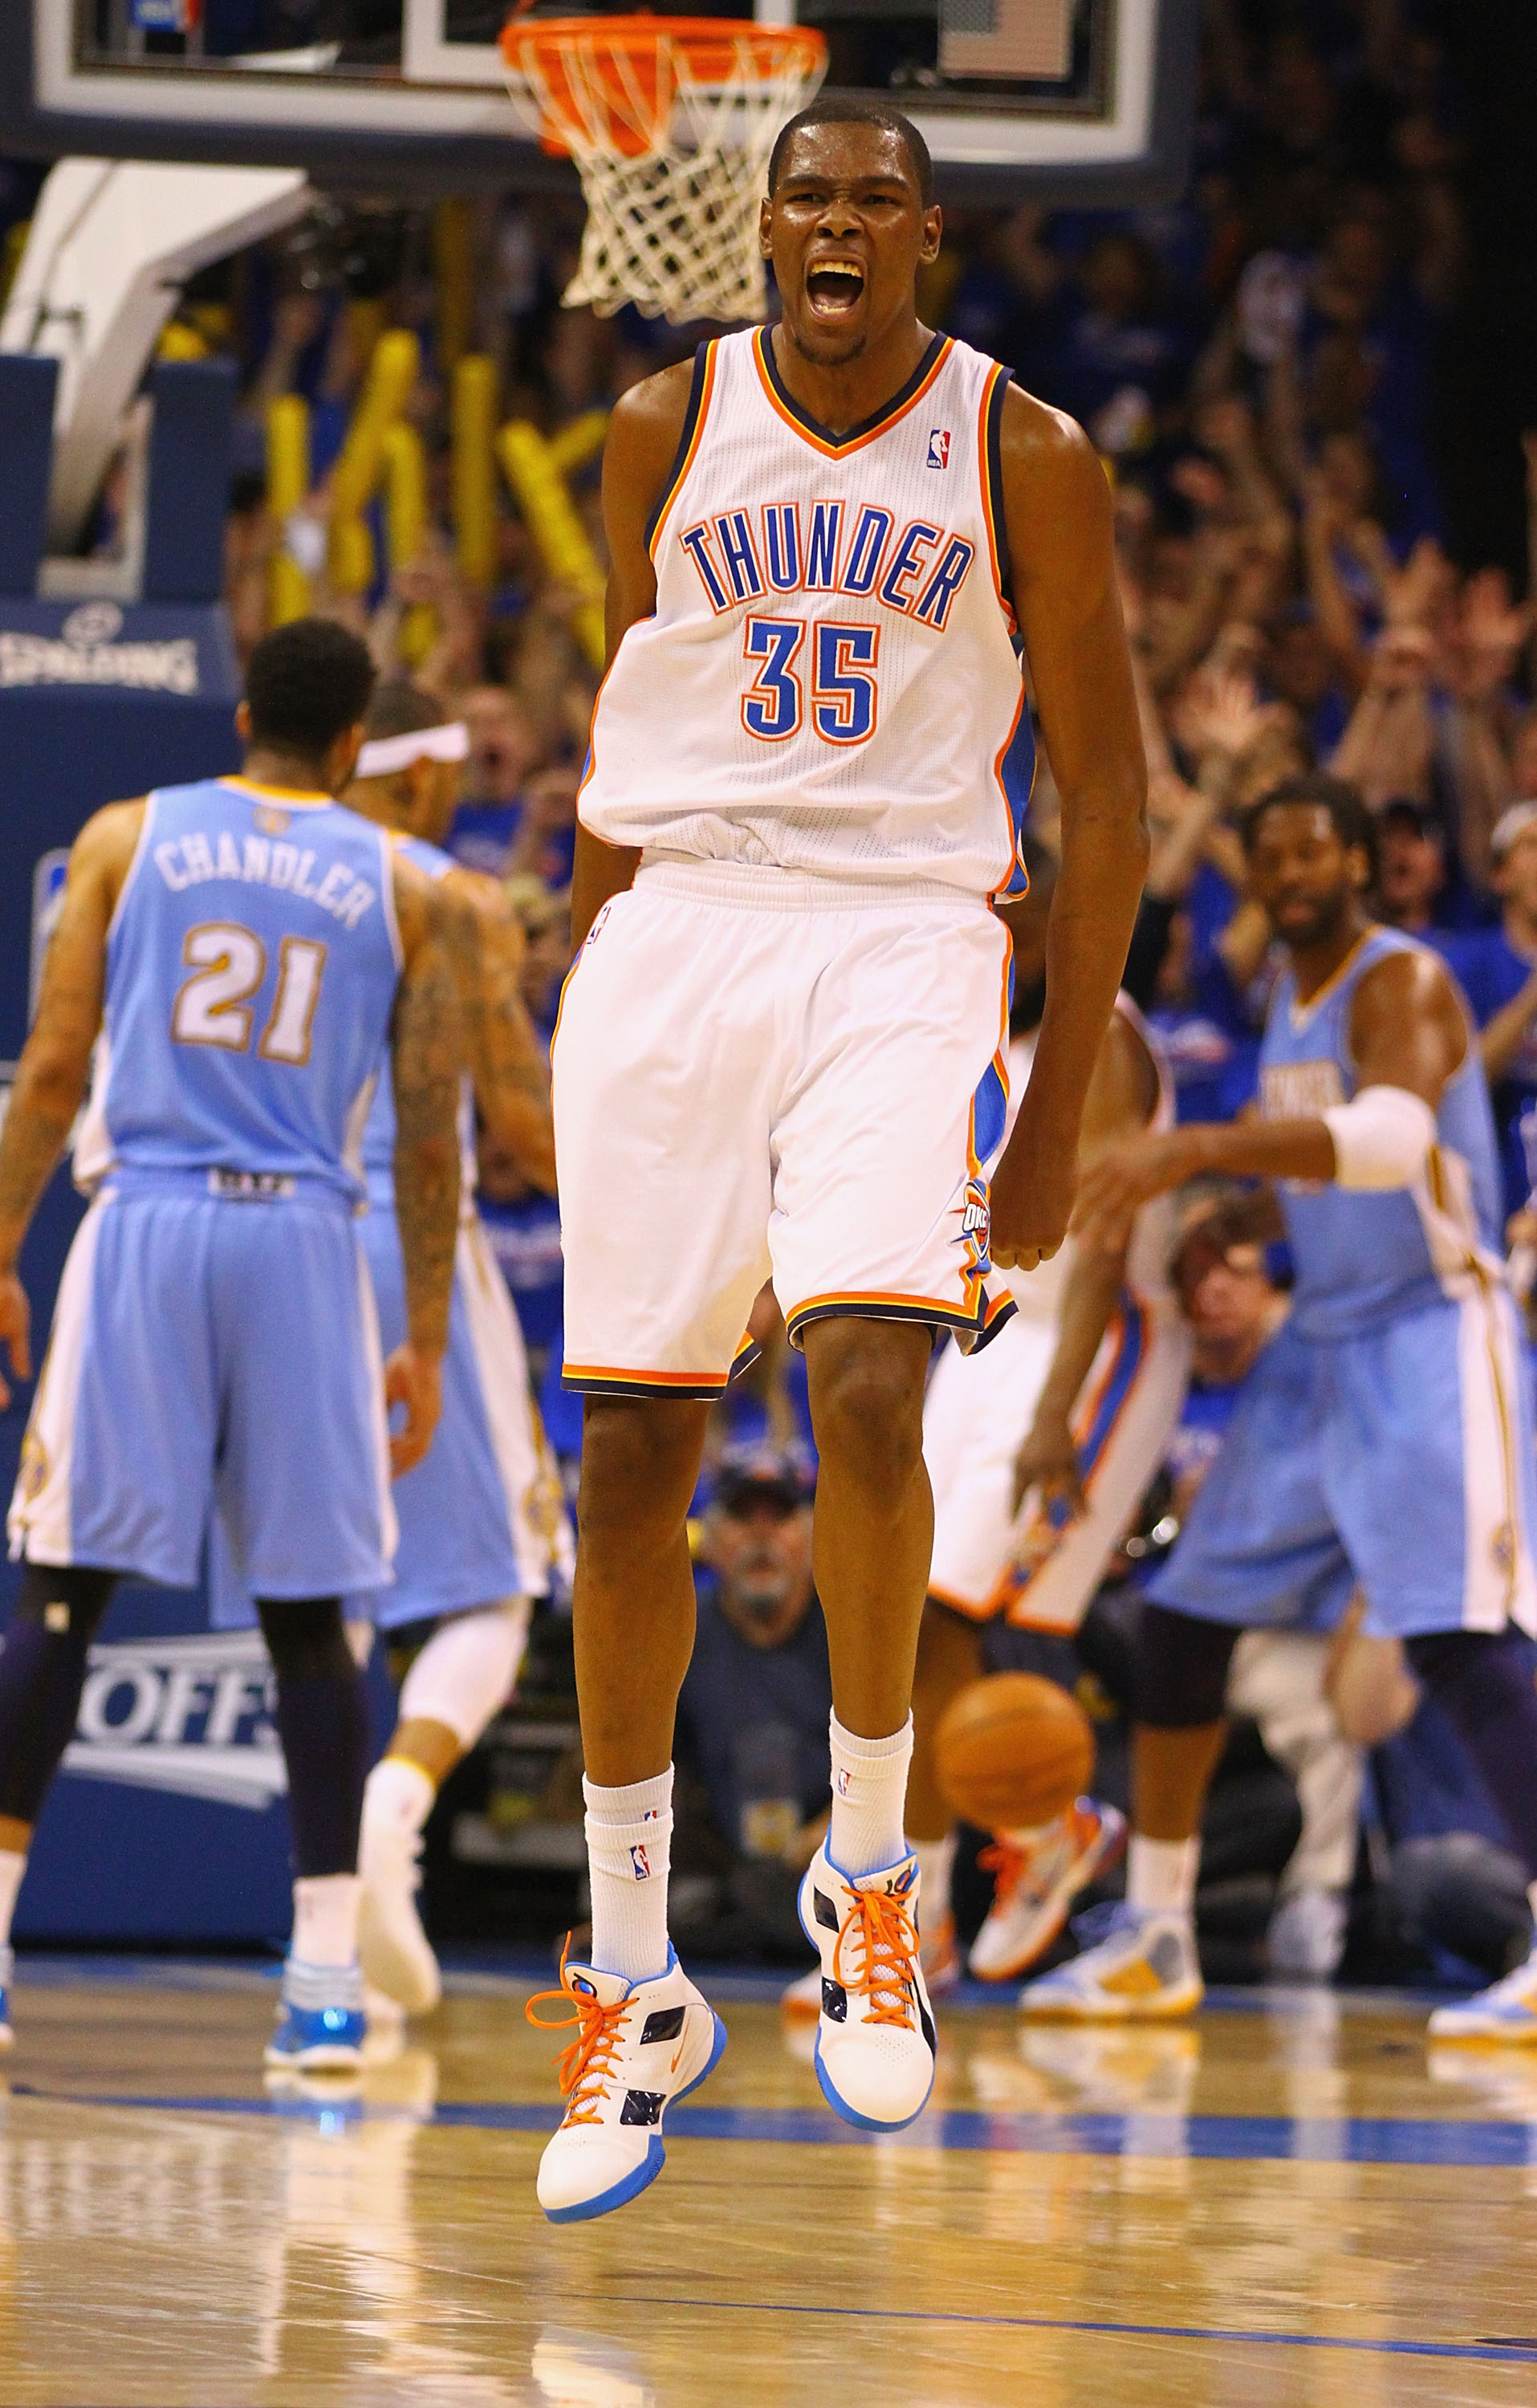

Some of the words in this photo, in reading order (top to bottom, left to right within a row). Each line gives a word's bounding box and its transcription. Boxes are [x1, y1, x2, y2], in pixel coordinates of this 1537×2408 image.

[679, 499, 975, 633] THUNDER
[740, 613, 881, 746] 35
[153, 832, 376, 930] CHANDLER
[170, 921, 330, 1069] 21
